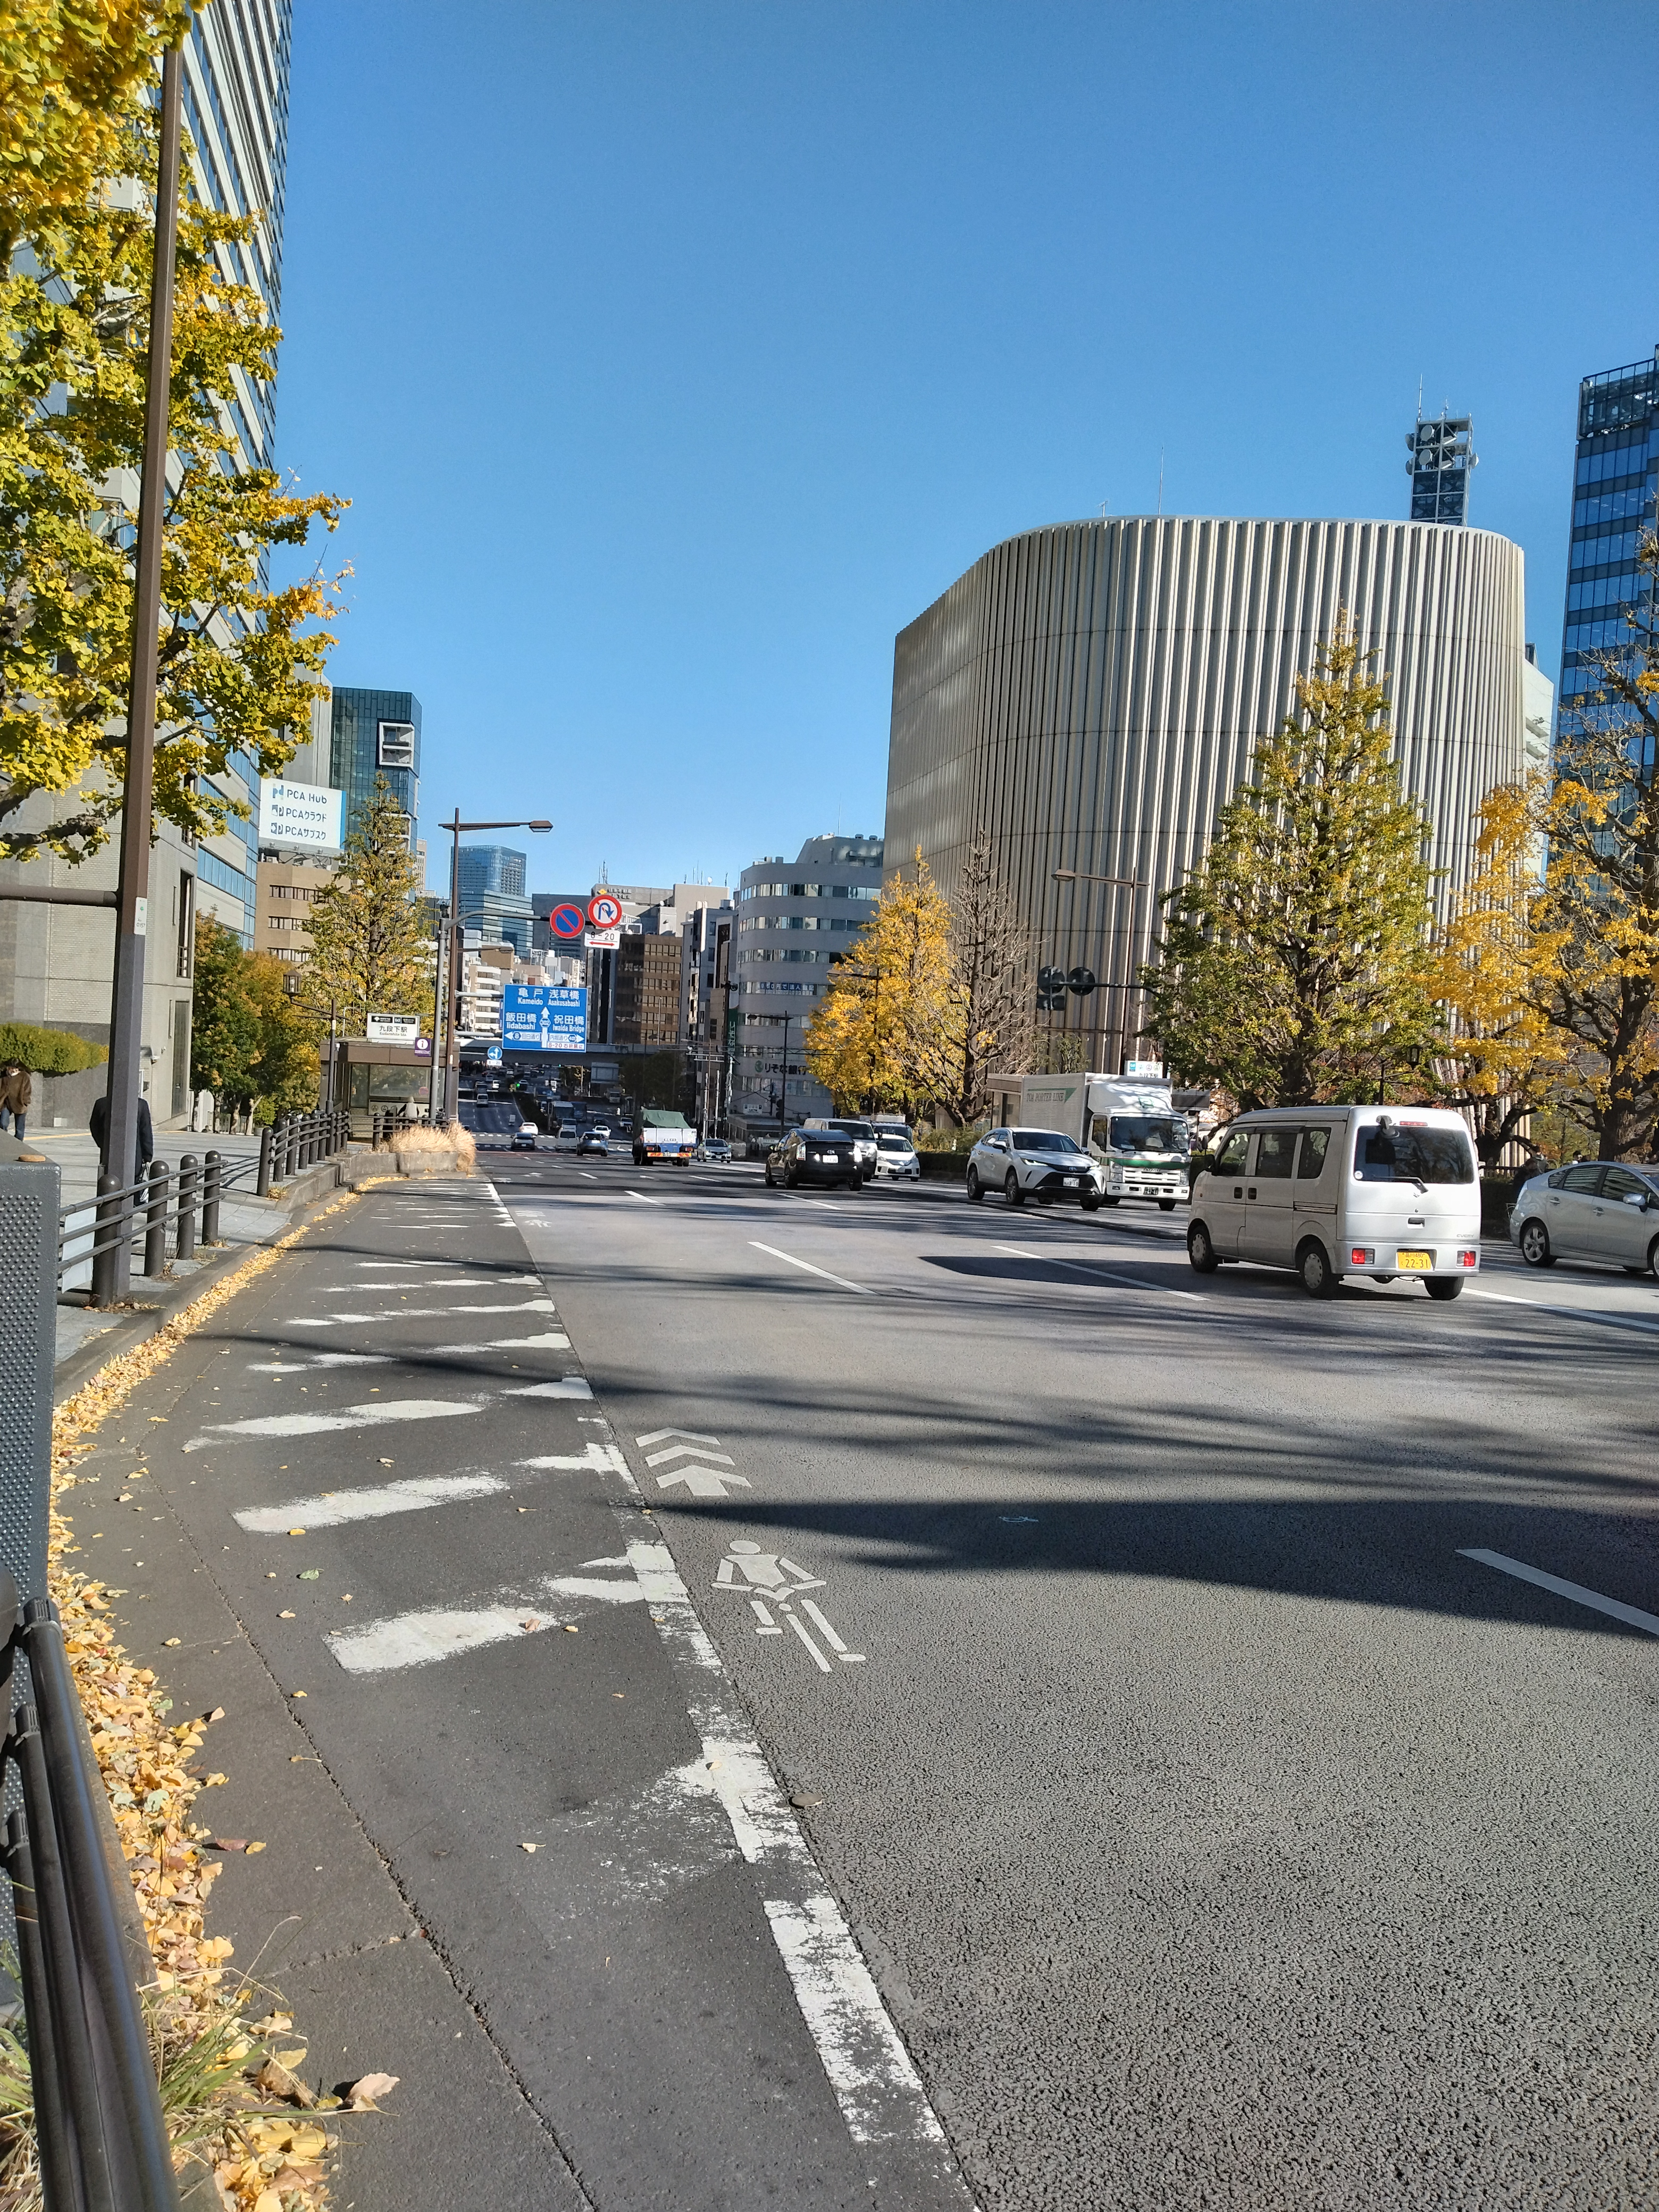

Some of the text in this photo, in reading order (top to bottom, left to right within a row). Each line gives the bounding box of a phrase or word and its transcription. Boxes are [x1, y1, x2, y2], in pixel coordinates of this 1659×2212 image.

[287, 789, 327, 803] PCA Hub
[286, 808, 326, 822] PCAクラウド
[285, 826, 326, 840] PCAサブスク
[518, 987, 543, 998] 亀戸
[549, 989, 580, 1000] 浅草橋
[505, 1012, 537, 1023] 飯田橋
[554, 1014, 584, 1025] 祝田橋
[765, 1063, 807, 1075] りそな銀行
[1405, 1259, 1428, 1268] 22-31
